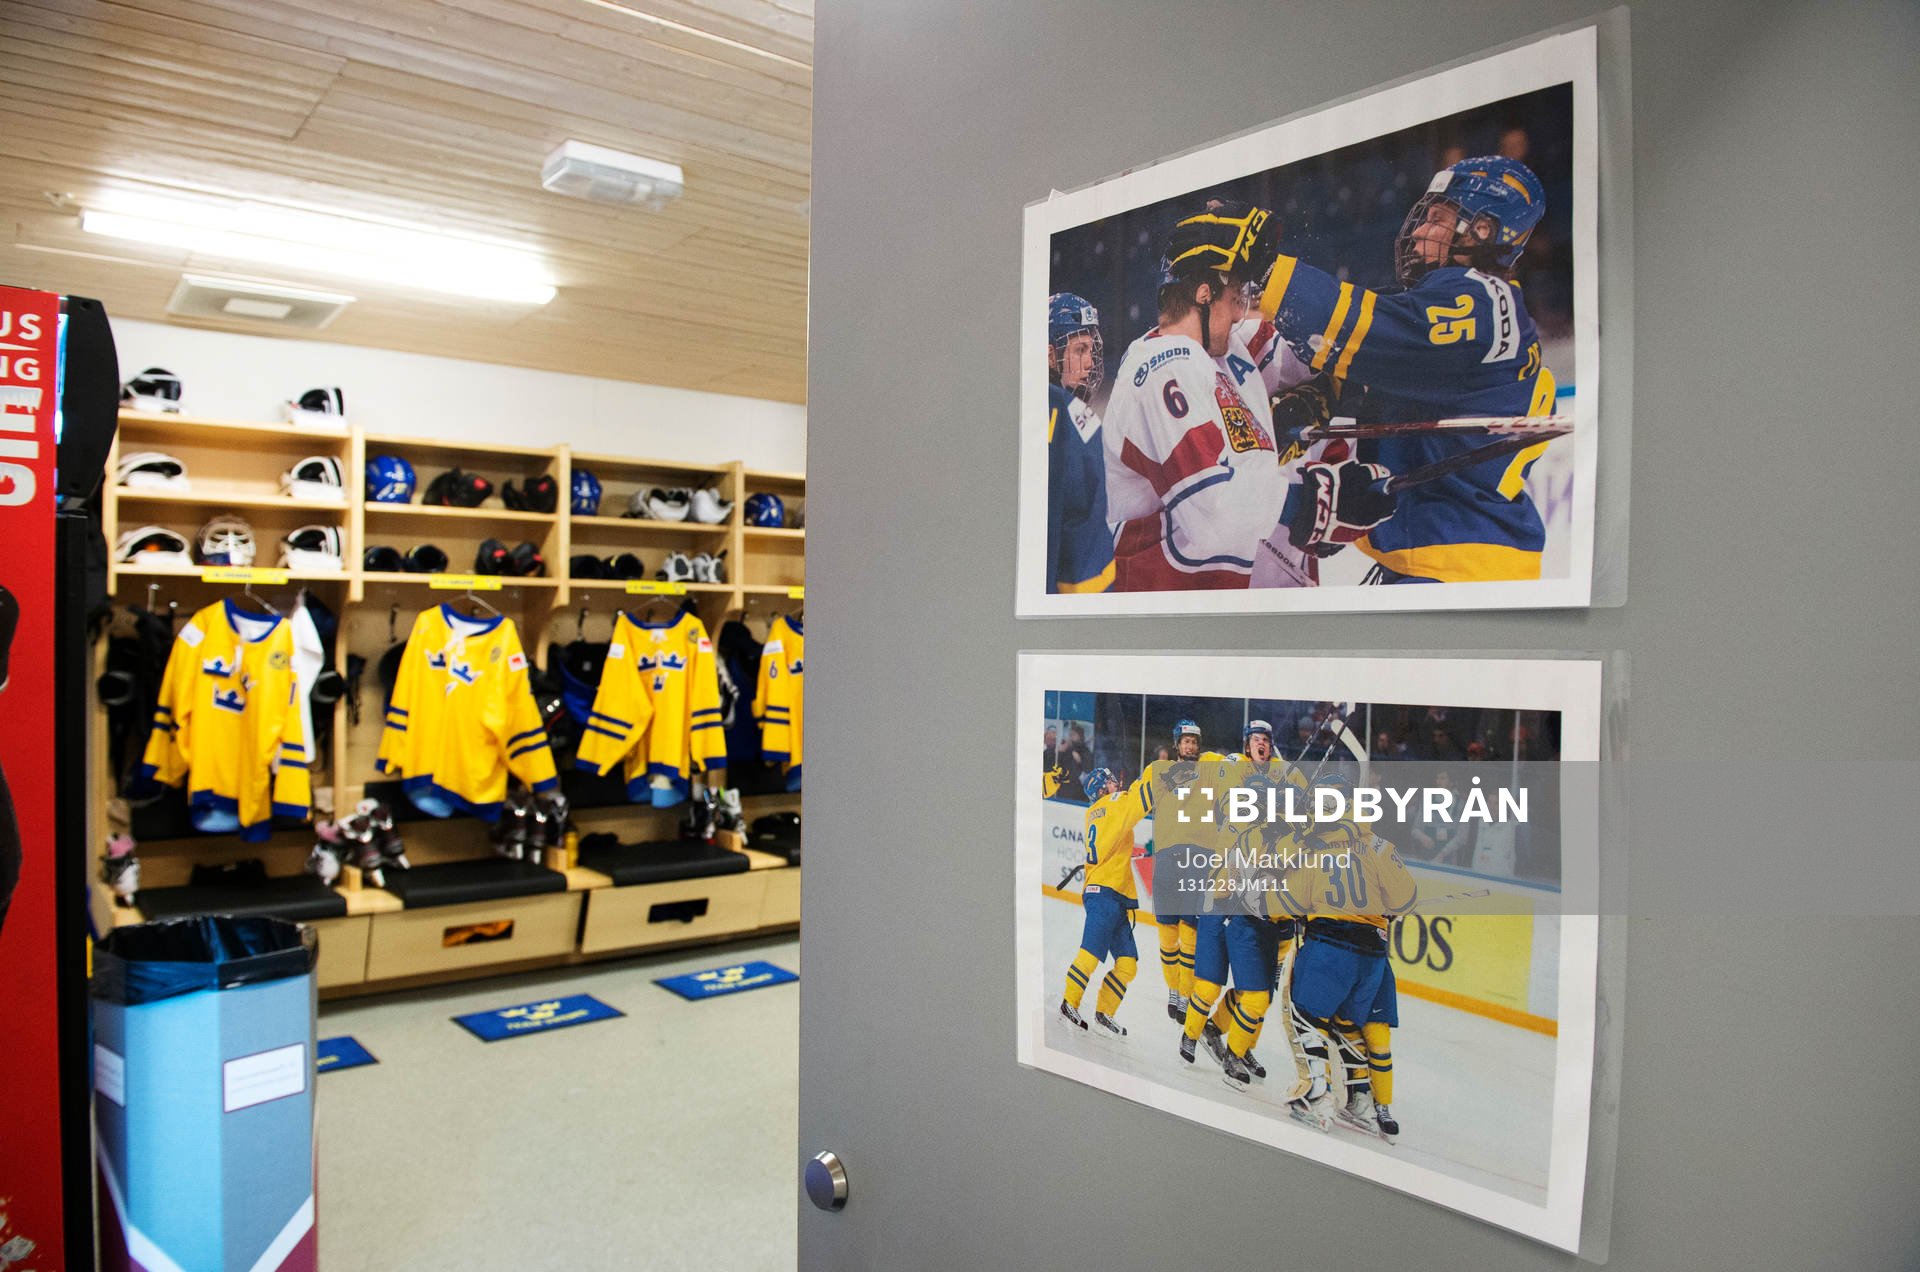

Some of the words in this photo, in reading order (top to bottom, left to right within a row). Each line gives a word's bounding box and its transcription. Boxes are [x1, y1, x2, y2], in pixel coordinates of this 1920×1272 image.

[1426, 294, 1476, 345] 25
[1226, 353, 1256, 386] A
[1162, 378, 1190, 419] 6
[1322, 852, 1369, 909] 30
